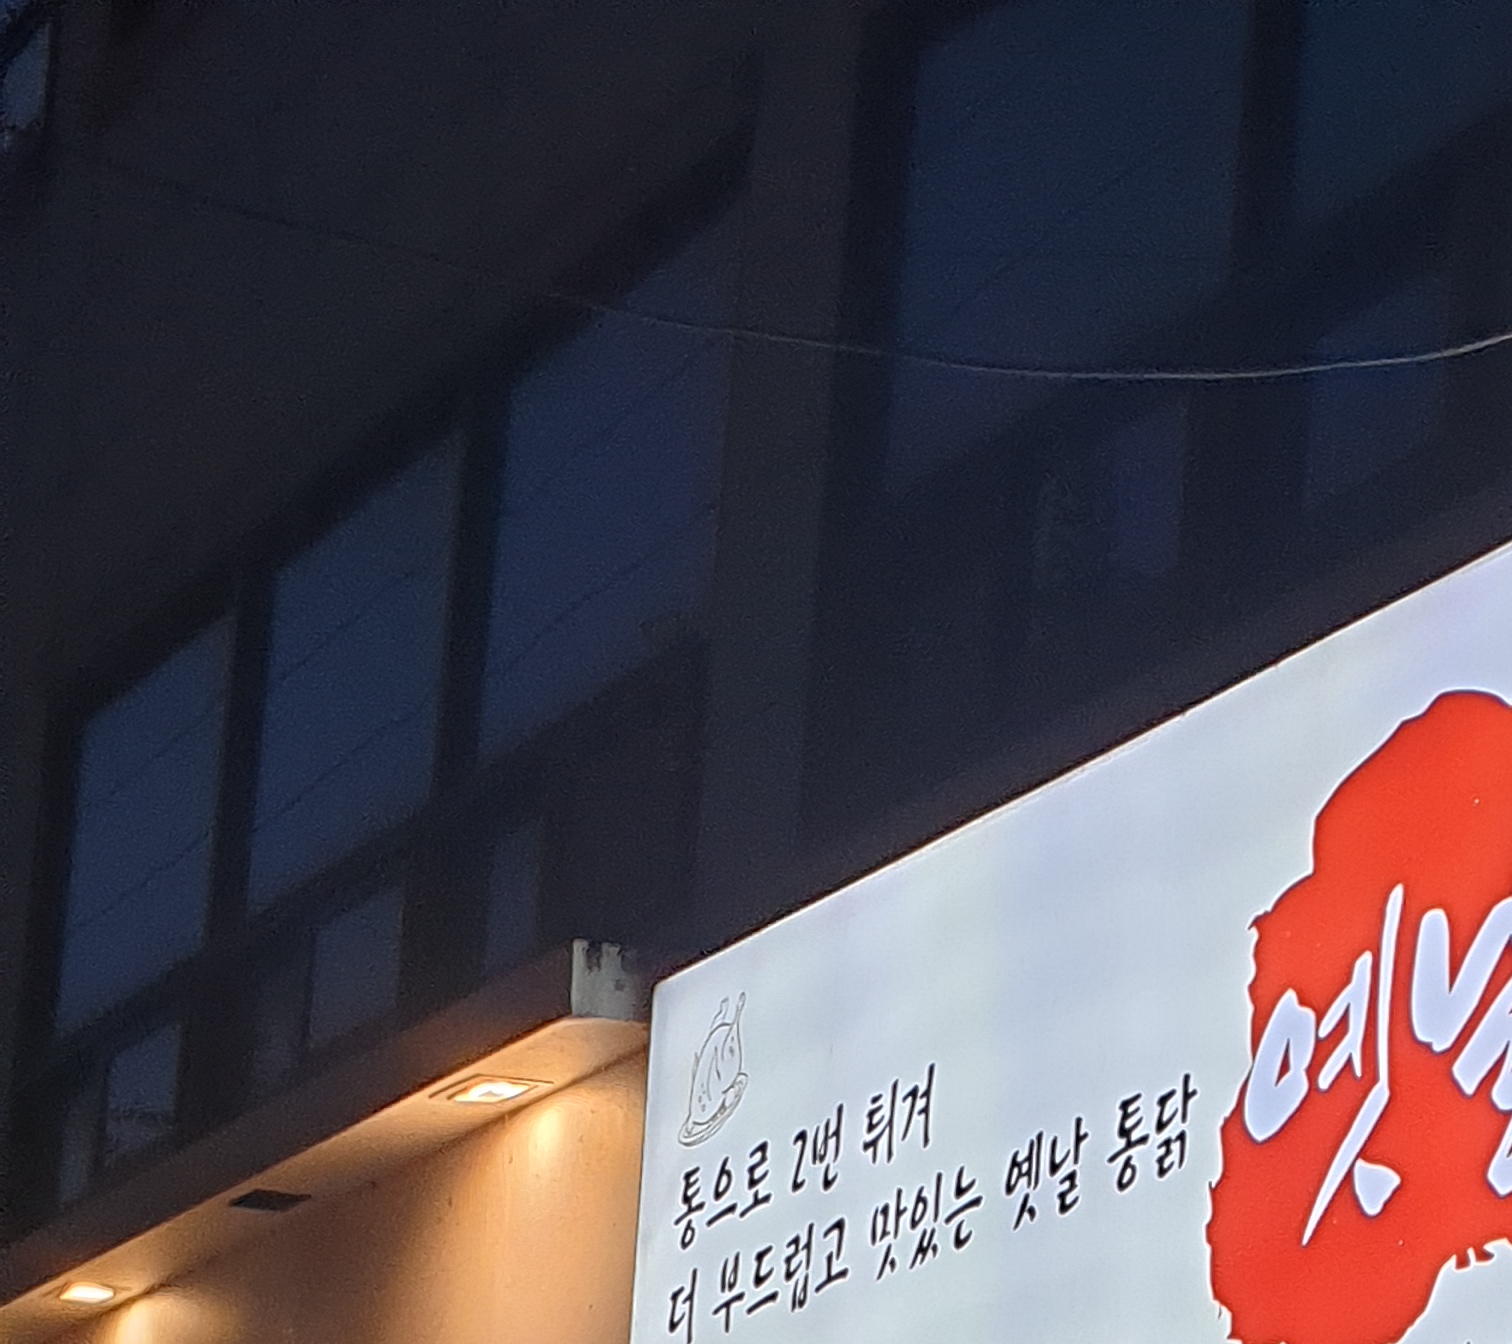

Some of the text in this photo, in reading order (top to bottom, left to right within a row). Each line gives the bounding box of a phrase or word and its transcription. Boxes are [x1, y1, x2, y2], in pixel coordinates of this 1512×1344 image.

[673, 1063, 939, 1251] 통으로 2번 튀겨
[711, 1217, 850, 1333] 부드럽고
[869, 1164, 985, 1280] 맛있는
[1003, 1116, 1090, 1232] 옛날
[1106, 1071, 1200, 1194] 통닭
